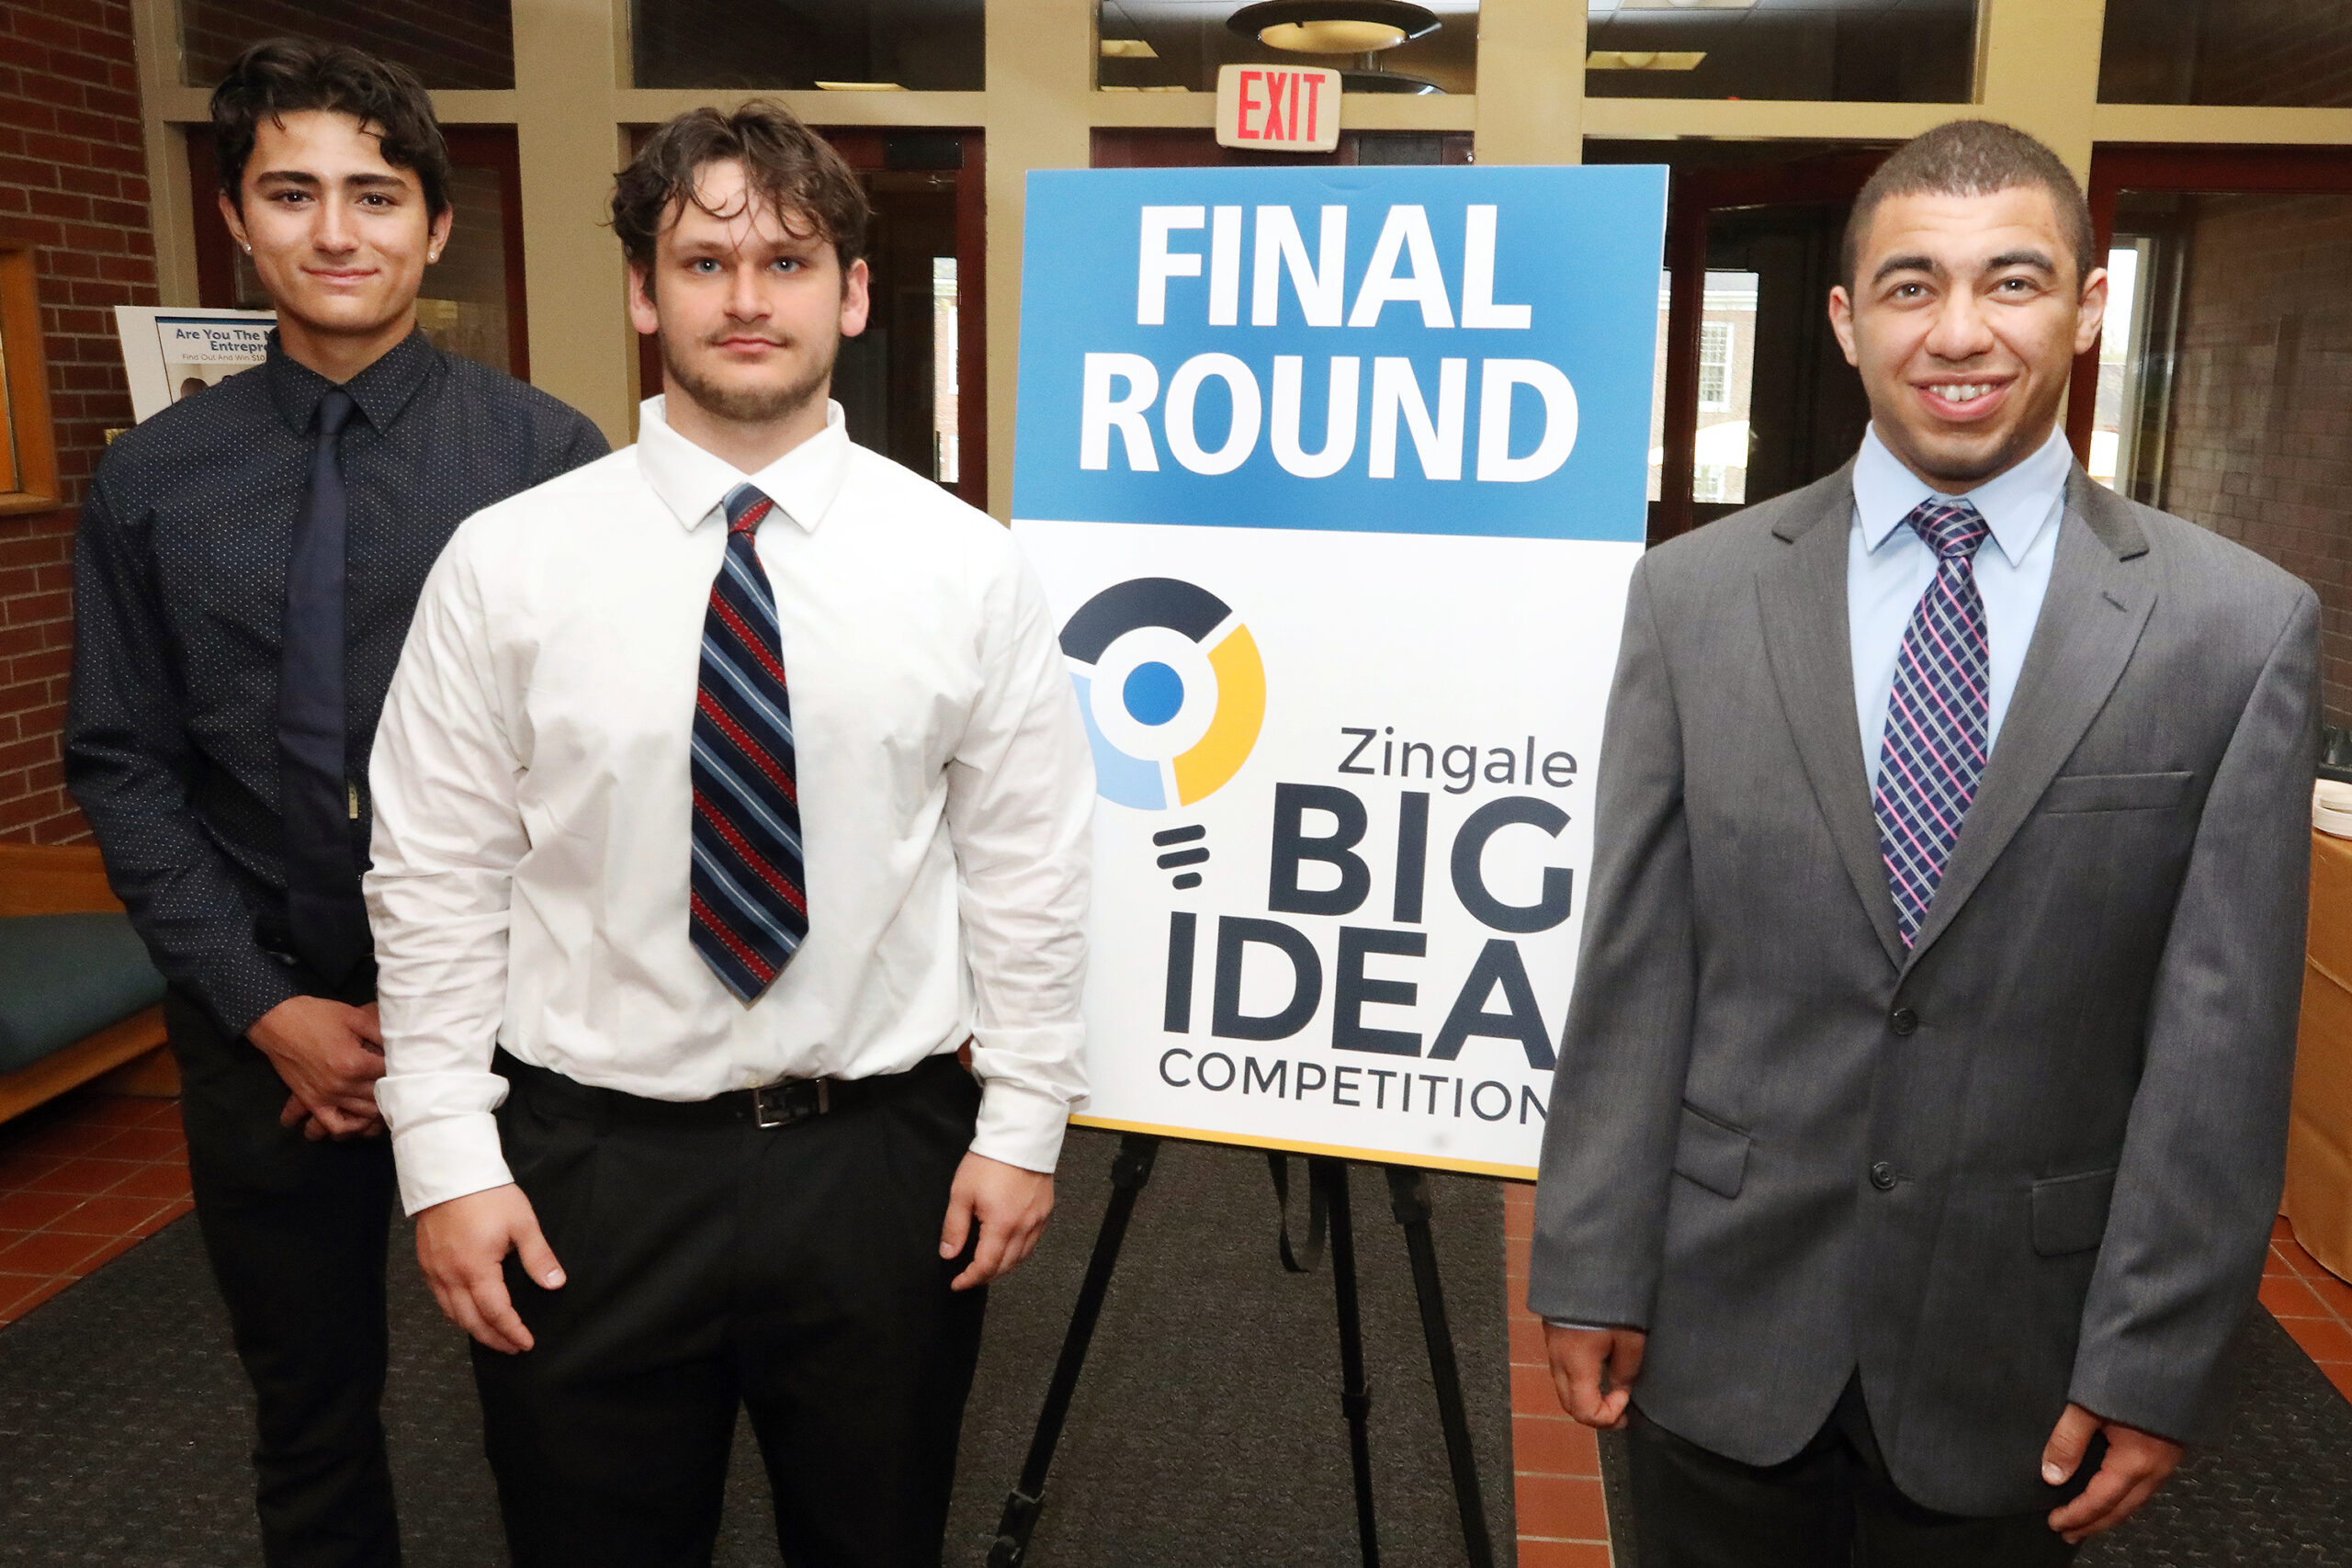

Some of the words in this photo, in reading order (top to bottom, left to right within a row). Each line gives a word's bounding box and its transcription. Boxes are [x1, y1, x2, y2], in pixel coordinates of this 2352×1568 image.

[1238, 71, 1326, 141] EXIT
[1137, 204, 1532, 329] FINAL
[176, 329, 199, 339] Are
[203, 329, 231, 340] You
[233, 330, 260, 341] The
[1080, 352, 1579, 482] ROUND
[1339, 727, 1578, 794] Zingale
[1268, 782, 1574, 934] BIG
[1163, 911, 1556, 1071] IDEA
[1159, 1049, 1547, 1124] COMPETITION
